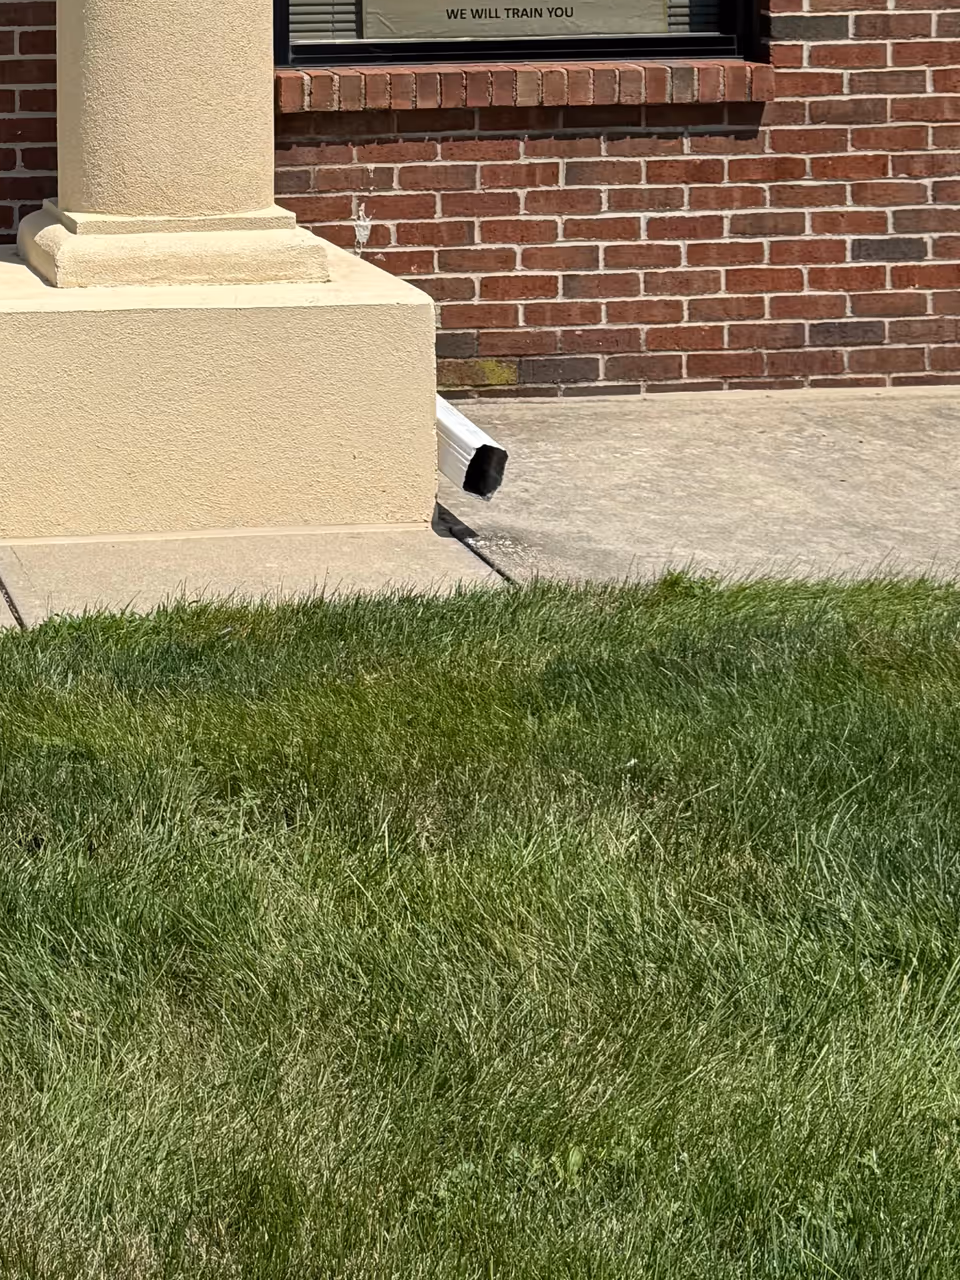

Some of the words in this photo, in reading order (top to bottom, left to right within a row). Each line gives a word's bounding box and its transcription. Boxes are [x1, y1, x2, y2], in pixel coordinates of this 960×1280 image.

[446, 8, 467, 20] WE
[470, 7, 501, 19] WILL
[504, 7, 544, 19] TRAIN
[546, 6, 574, 18] YOU
